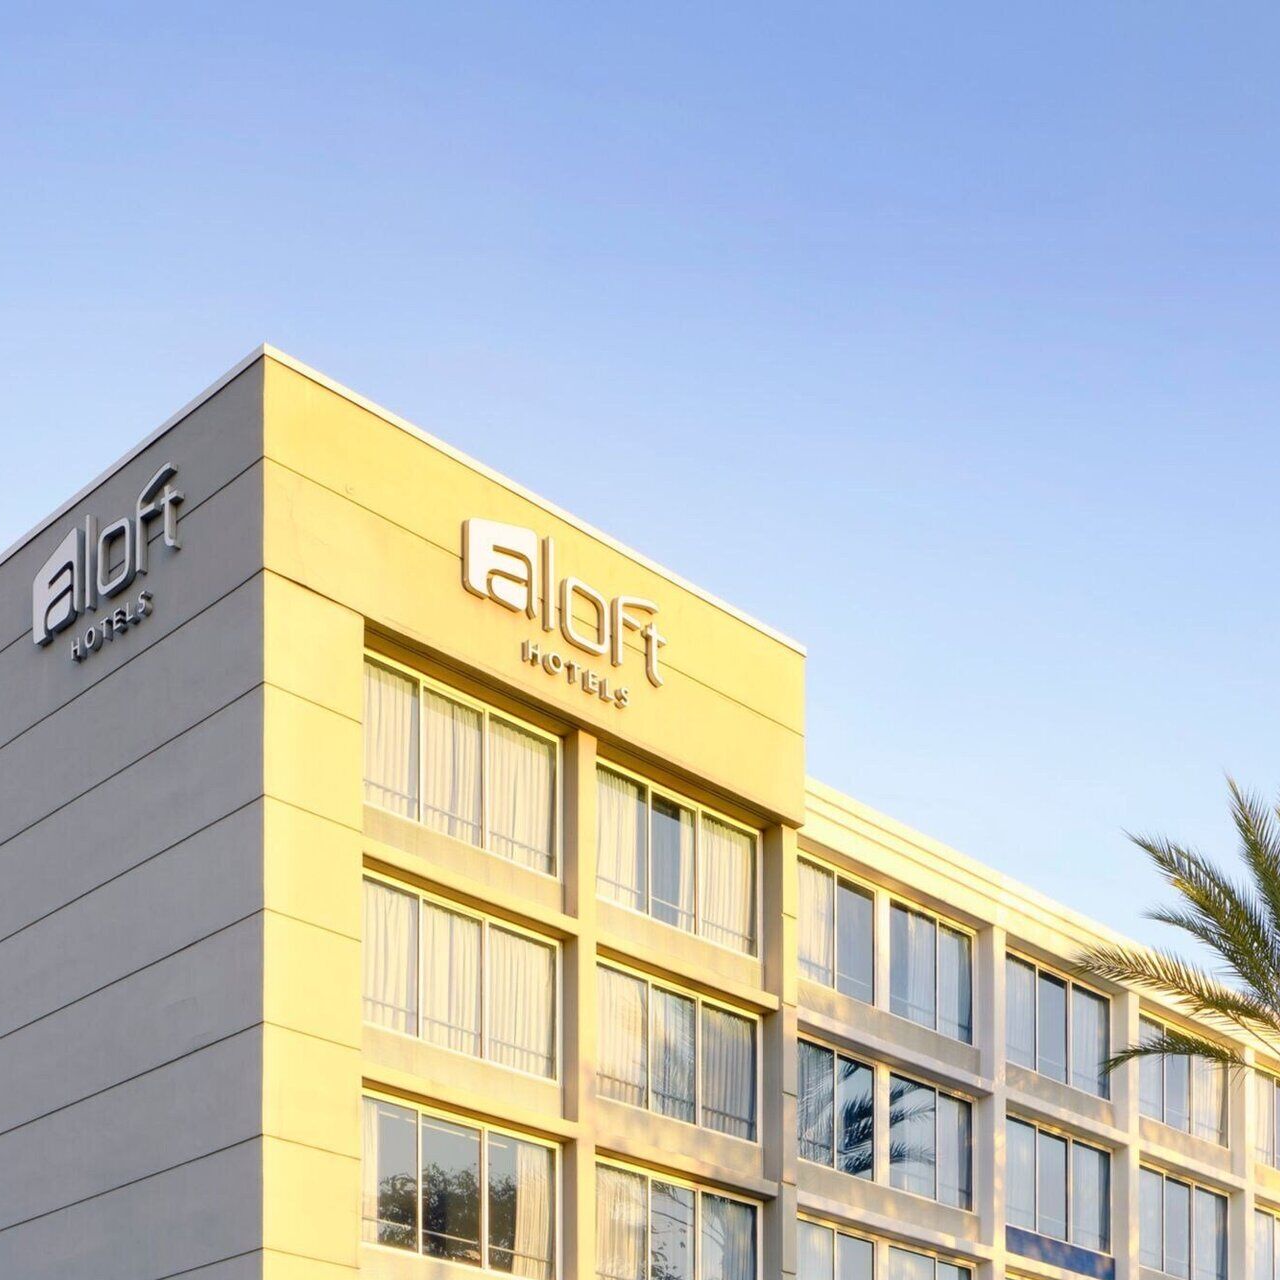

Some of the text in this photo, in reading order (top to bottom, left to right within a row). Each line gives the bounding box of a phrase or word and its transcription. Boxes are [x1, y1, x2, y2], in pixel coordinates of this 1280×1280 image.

[32, 462, 184, 645] aloft
[461, 517, 666, 688] aloft
[70, 591, 153, 662] HOTELS
[521, 640, 629, 709] HOTELS
